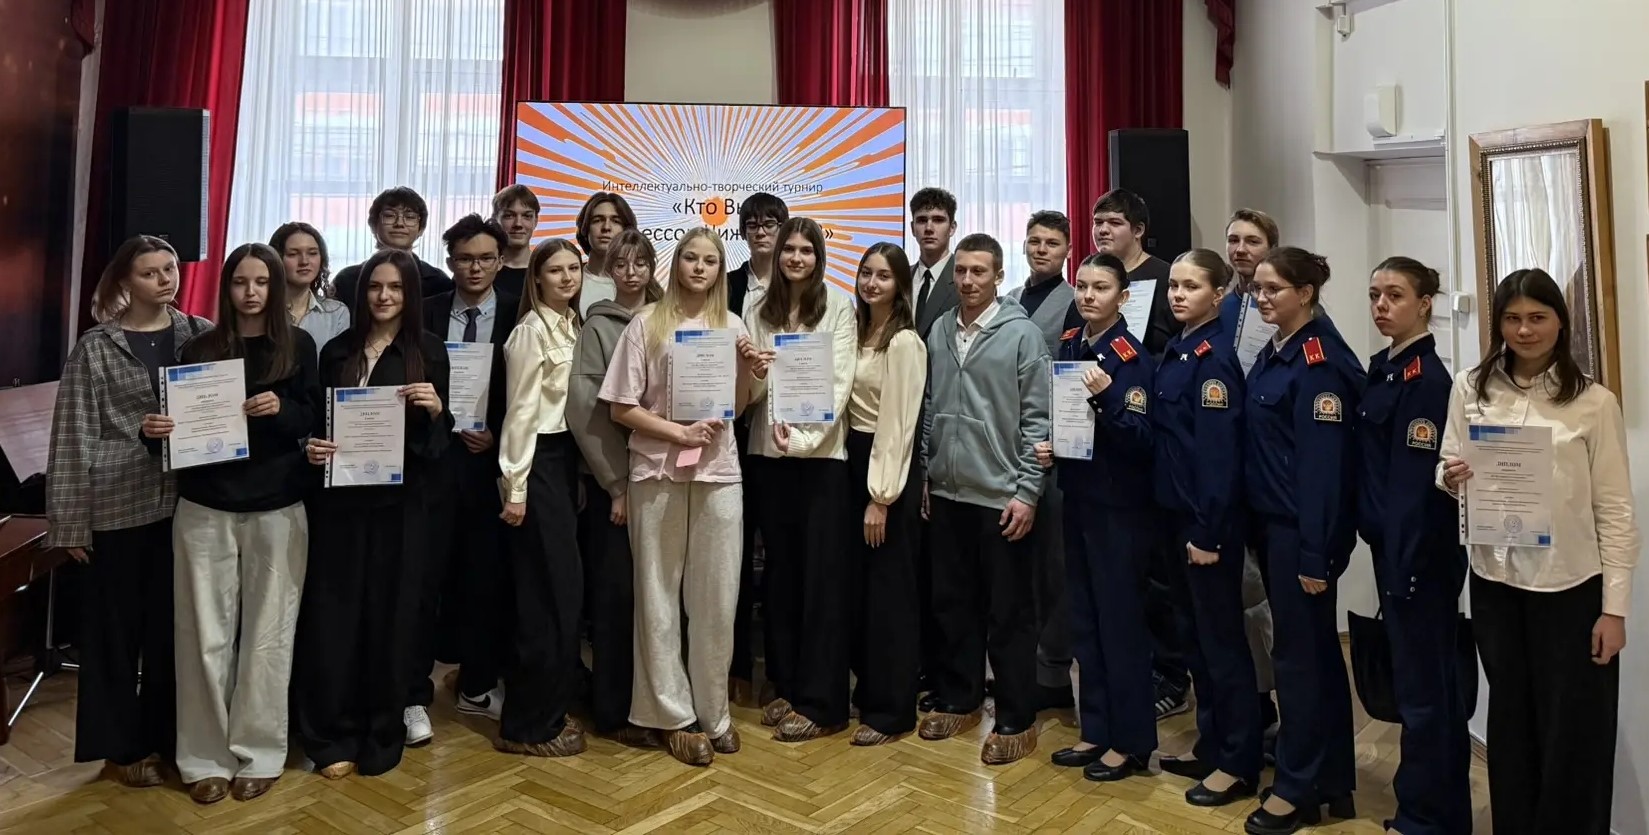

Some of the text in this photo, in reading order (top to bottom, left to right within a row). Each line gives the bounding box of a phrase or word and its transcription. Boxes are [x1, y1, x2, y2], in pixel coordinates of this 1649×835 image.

[602, 181, 823, 194] Интеллектуально-творческий турнир
[672, 198, 717, 215] «Кто
